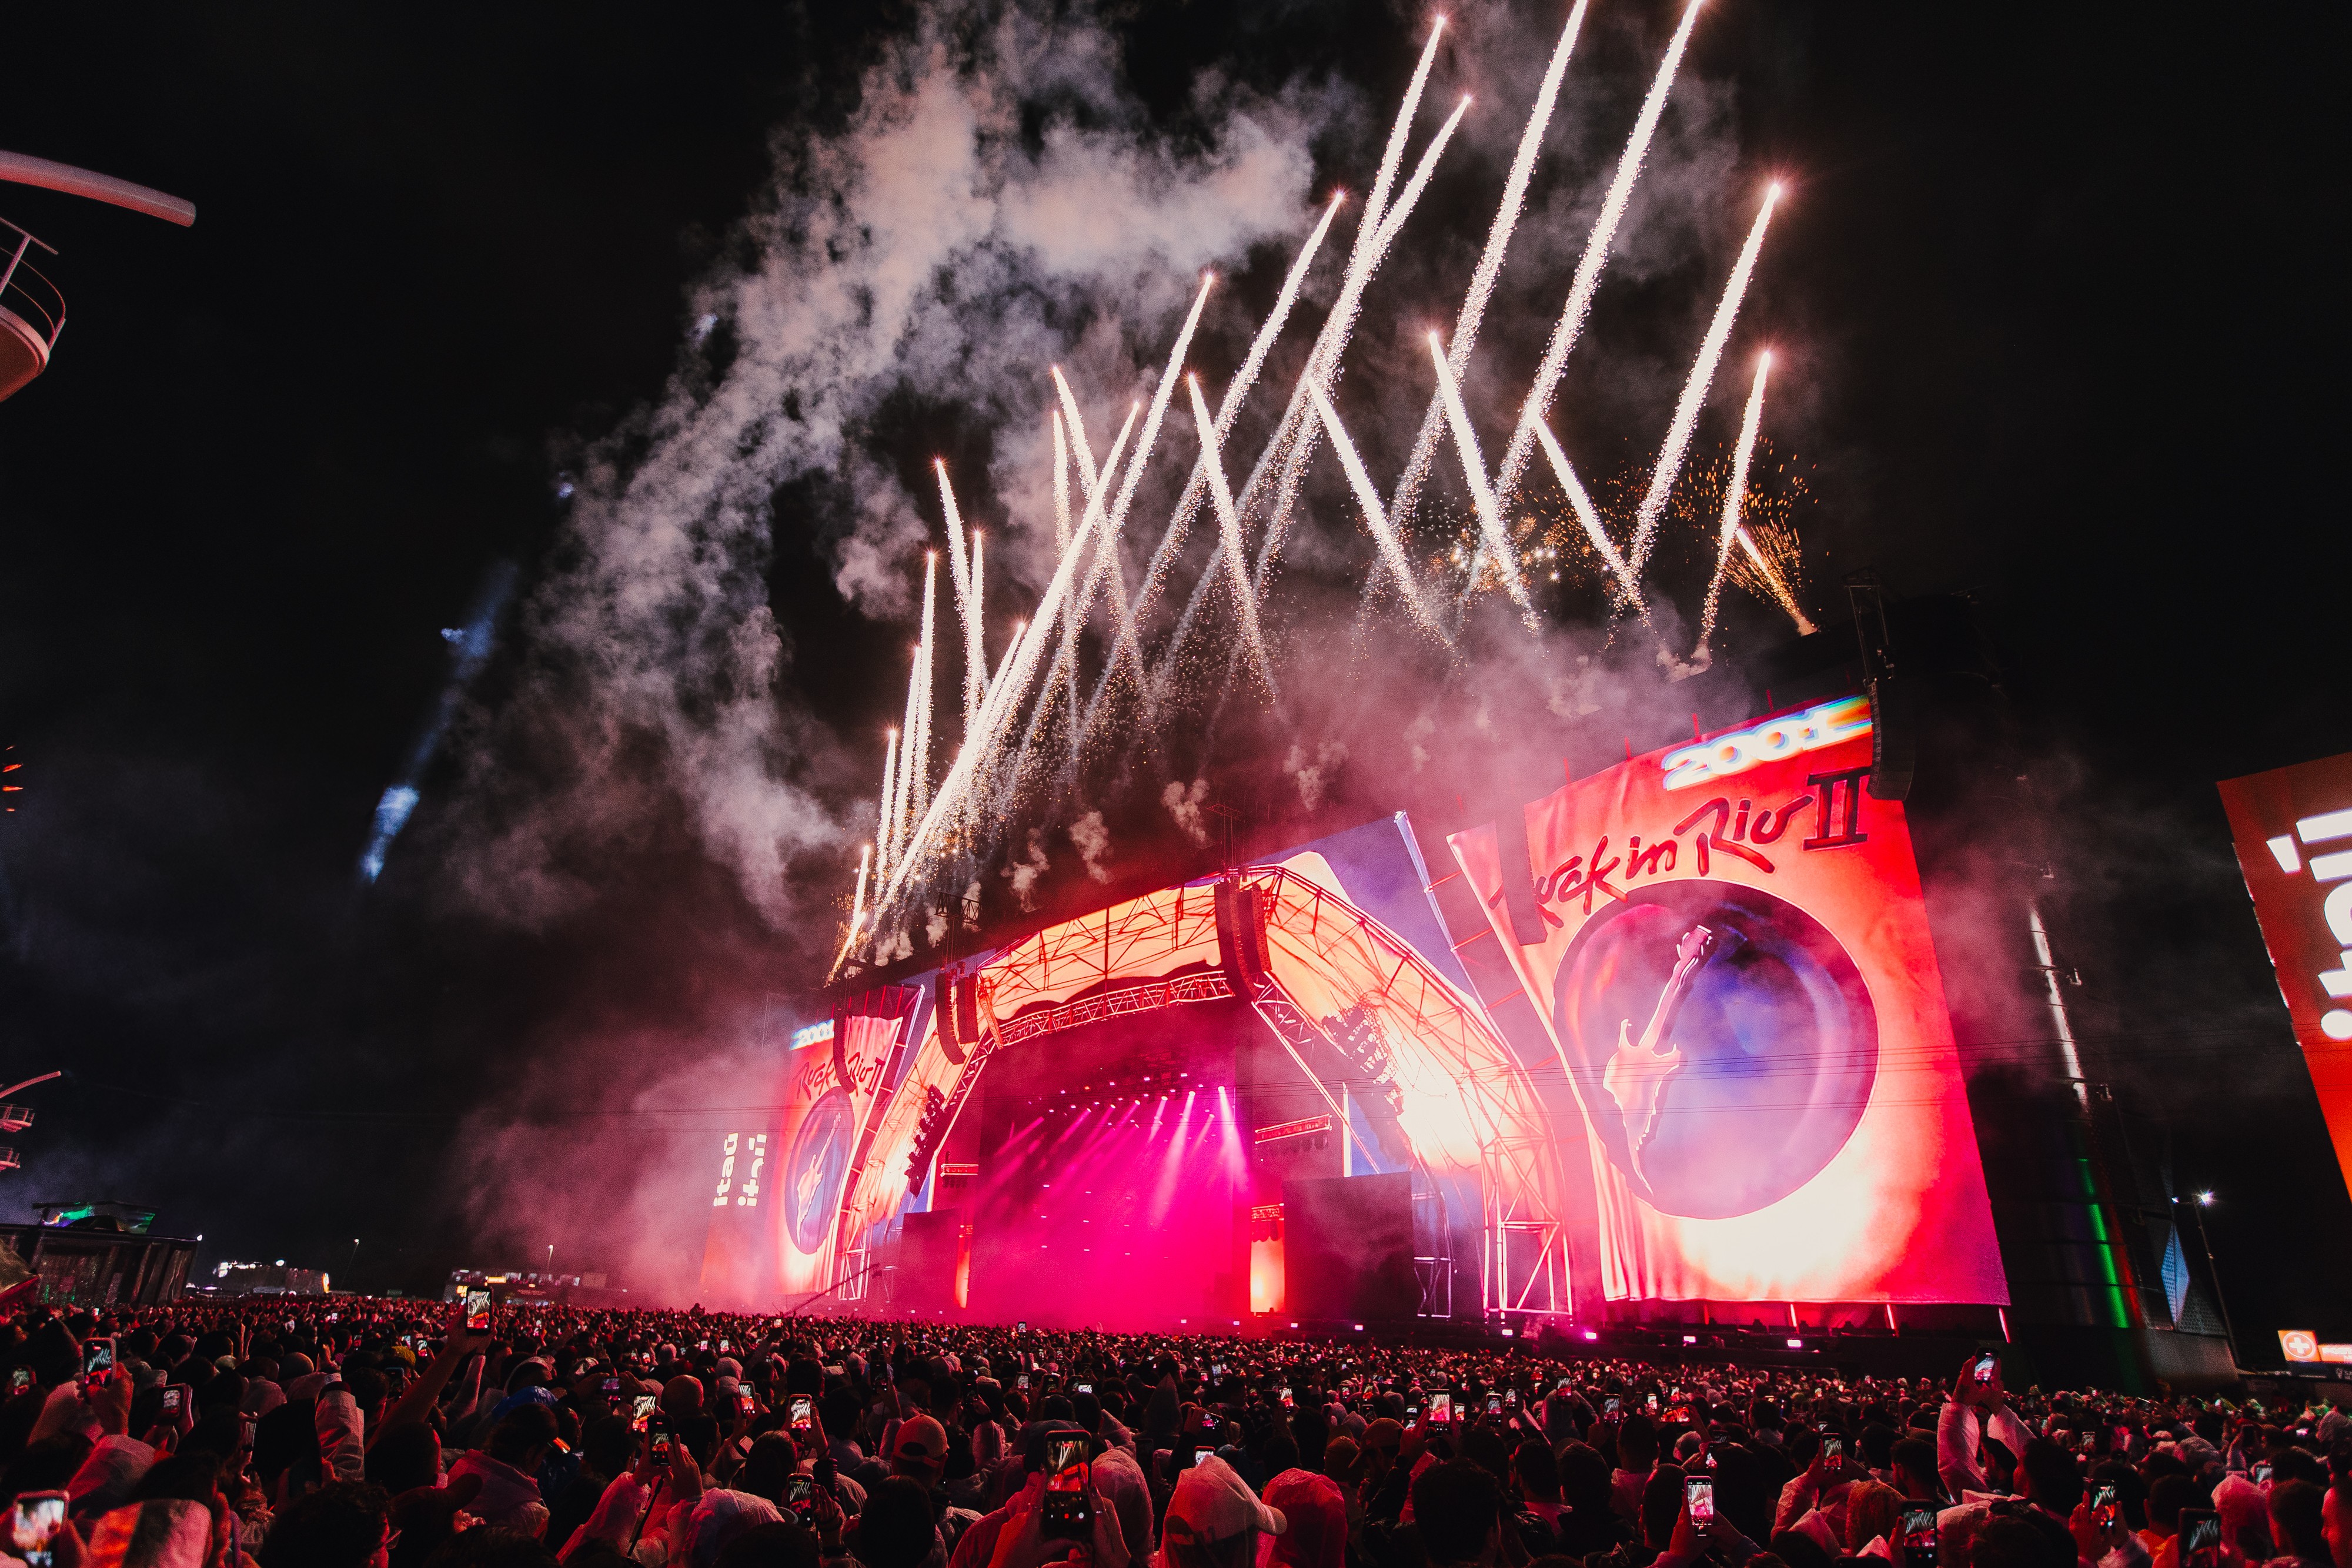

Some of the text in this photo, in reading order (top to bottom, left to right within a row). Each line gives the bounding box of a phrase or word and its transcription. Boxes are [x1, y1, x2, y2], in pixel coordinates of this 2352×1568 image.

[1662, 704, 1843, 791] 2001
[1625, 835, 1678, 880] in
[1672, 797, 1814, 877] Rio
[1803, 767, 1871, 851] II
[793, 1058, 836, 1101] Rock
[848, 1051, 874, 1098] Rio
